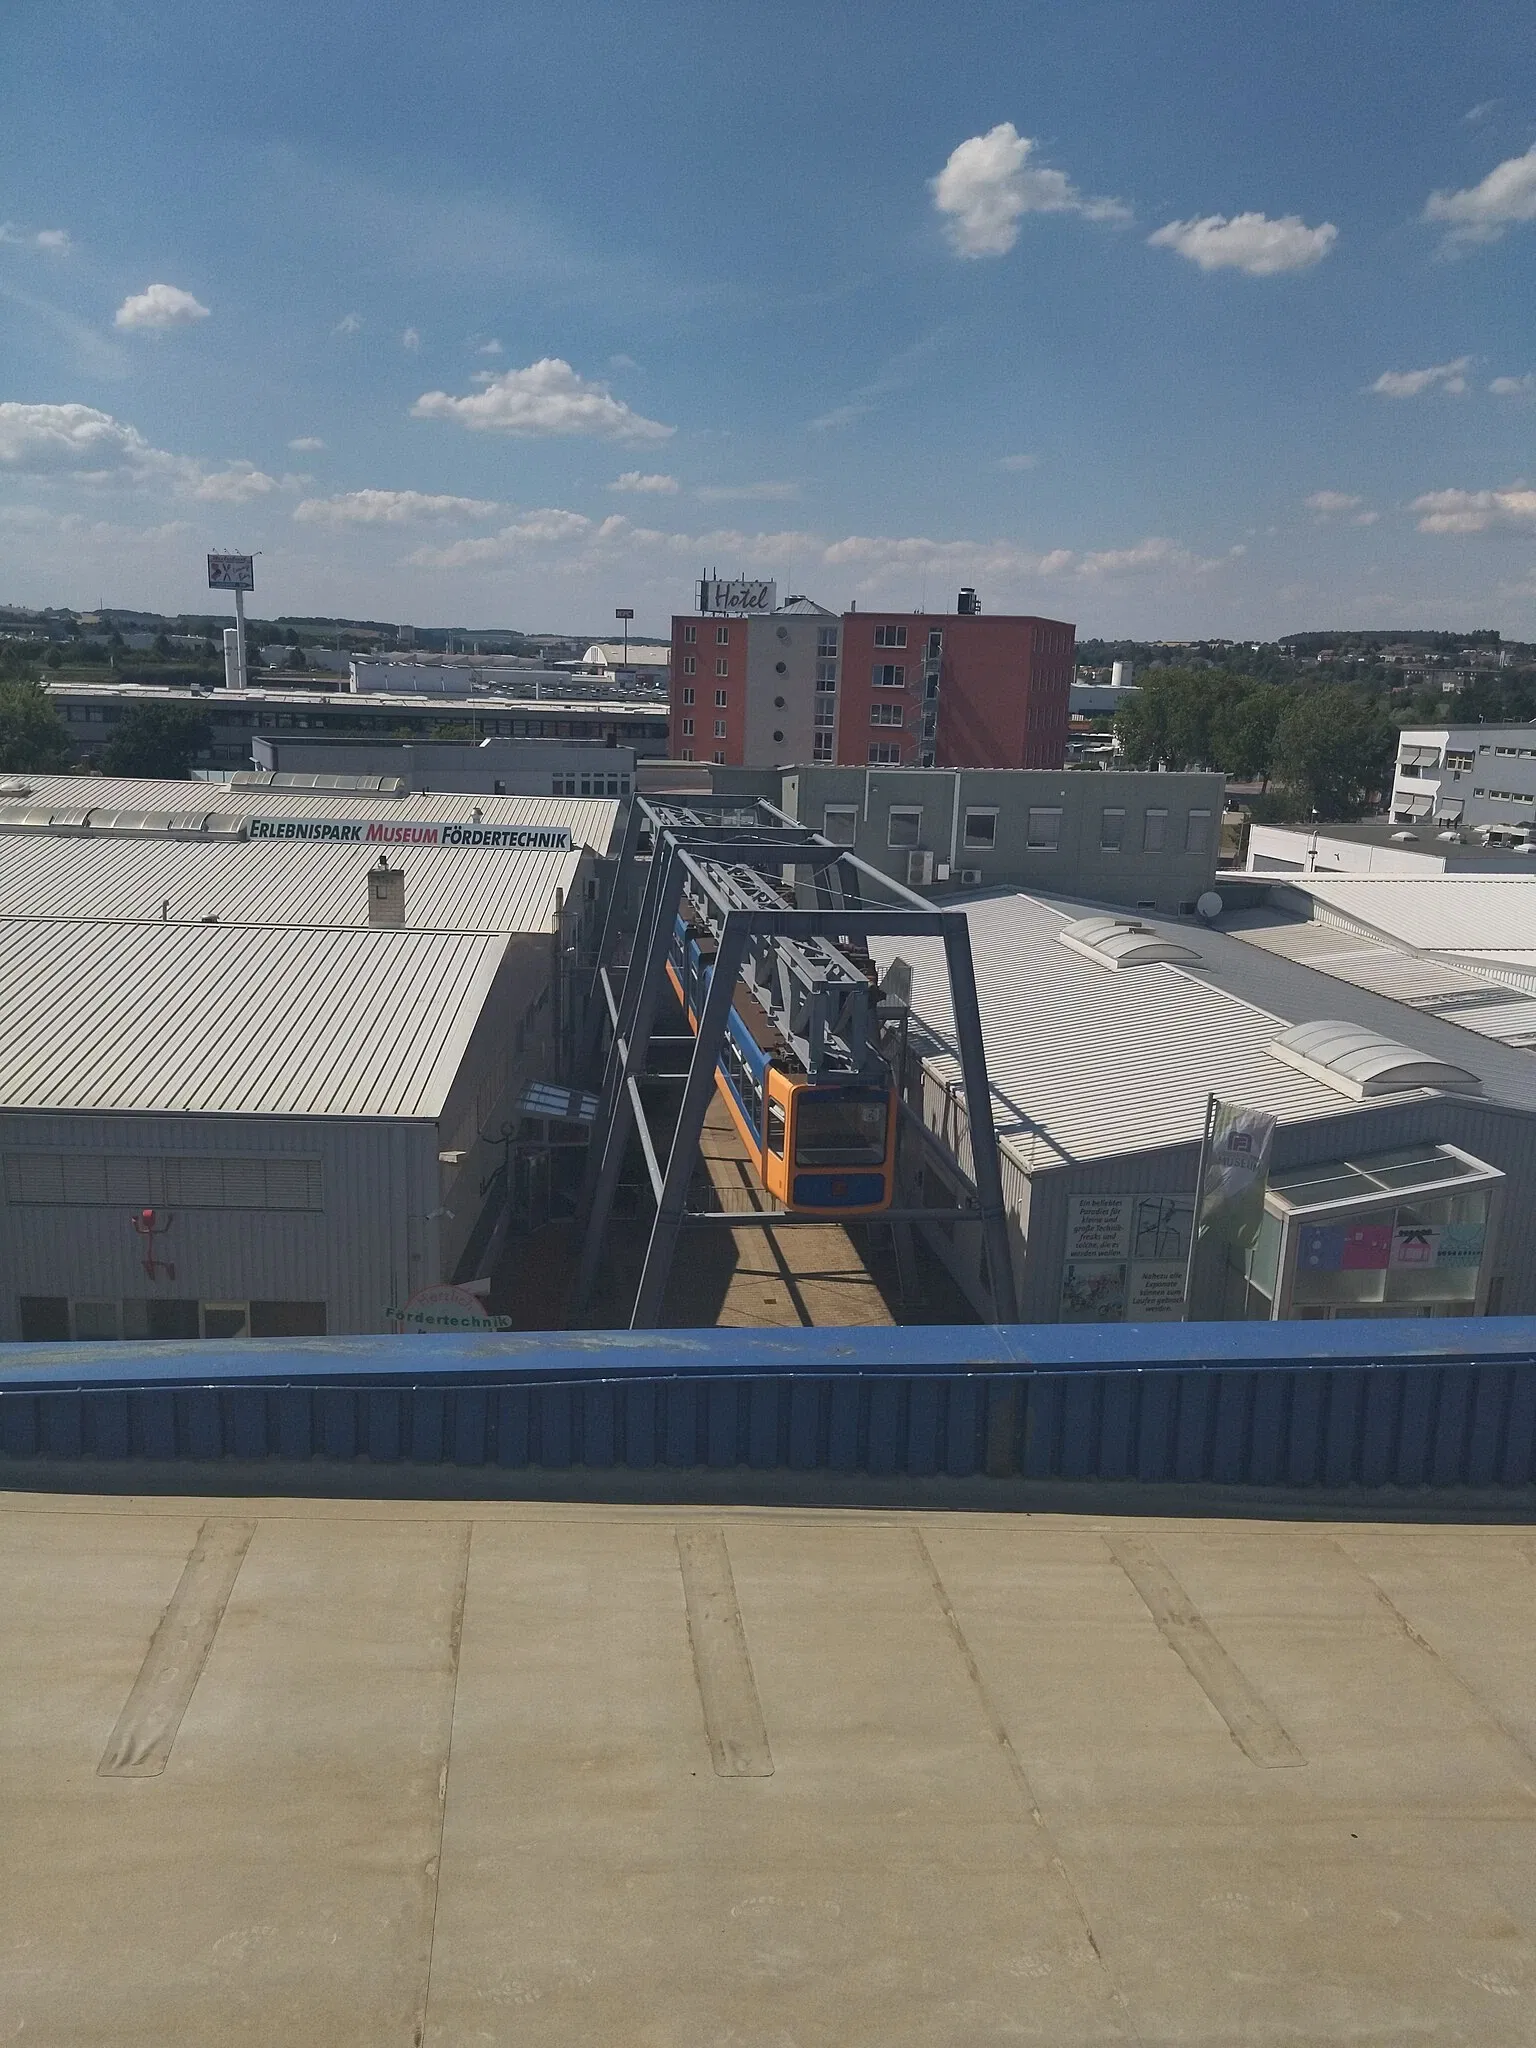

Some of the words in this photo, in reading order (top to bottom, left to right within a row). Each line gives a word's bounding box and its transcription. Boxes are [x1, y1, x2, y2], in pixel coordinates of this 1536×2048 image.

[715, 584, 768, 609] Hotel
[250, 819, 362, 841] ERLEBNISPARK
[366, 823, 438, 844] MUSEUM
[441, 825, 567, 848] FÖRDERTECHNIK
[1079, 1199, 1091, 1207] Ein
[1109, 1207, 1121, 1216] für
[1103, 1232, 1117, 1240] und
[385, 1307, 508, 1328] Fördertechnik
